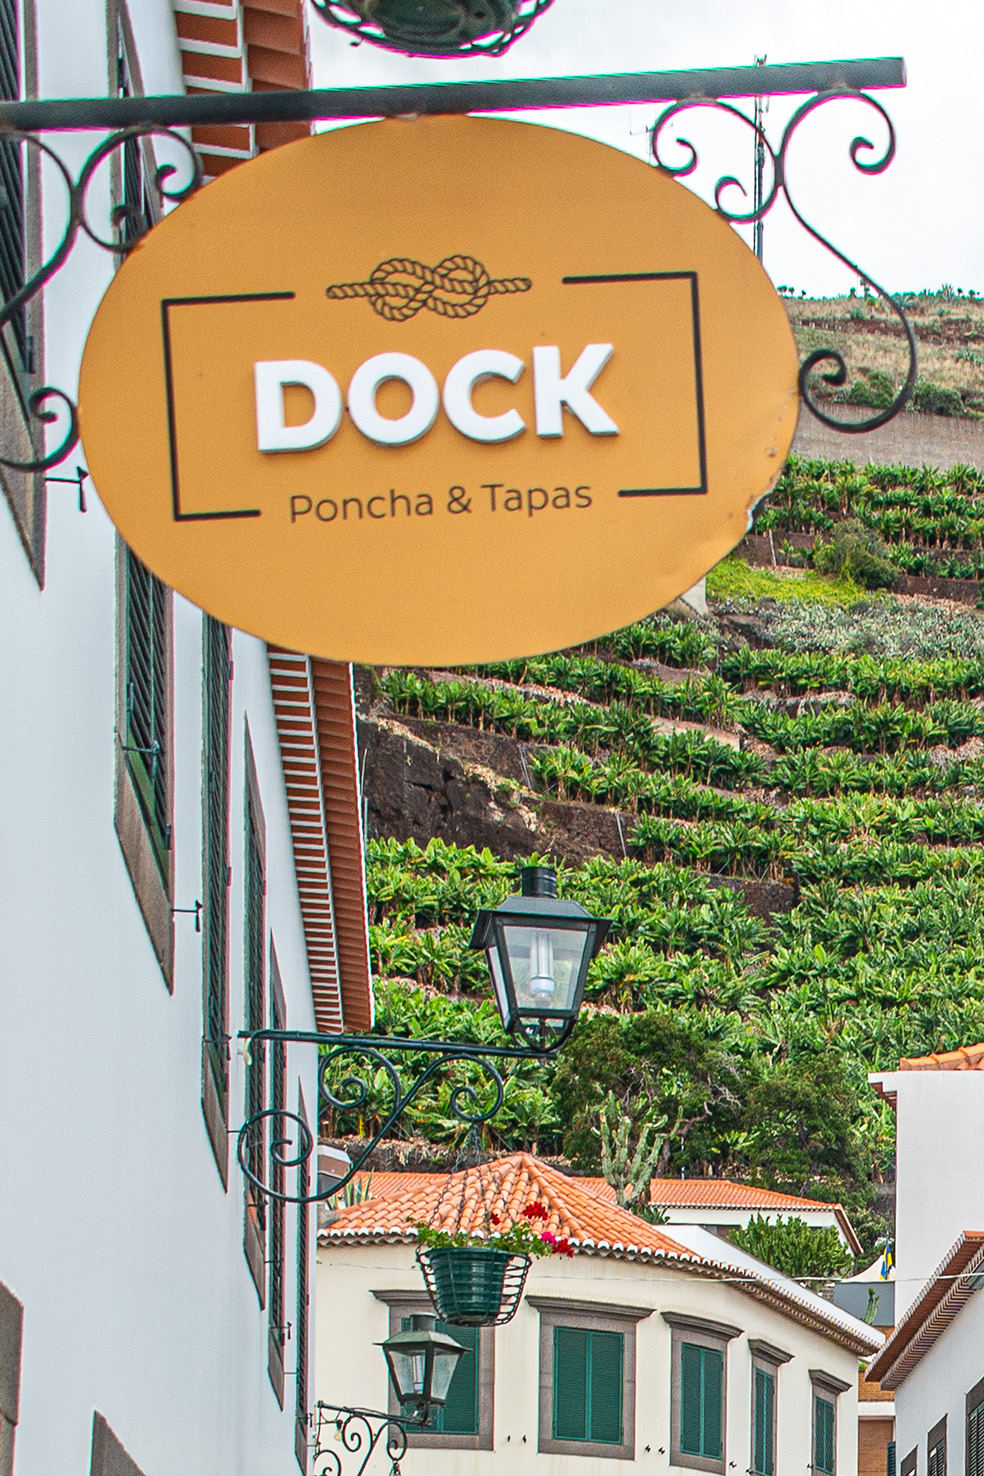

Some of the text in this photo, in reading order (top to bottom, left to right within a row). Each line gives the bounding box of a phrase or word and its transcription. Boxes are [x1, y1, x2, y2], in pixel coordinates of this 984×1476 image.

[254, 343, 619, 454] DOCK
[289, 482, 594, 523] Poncha & Tapas
